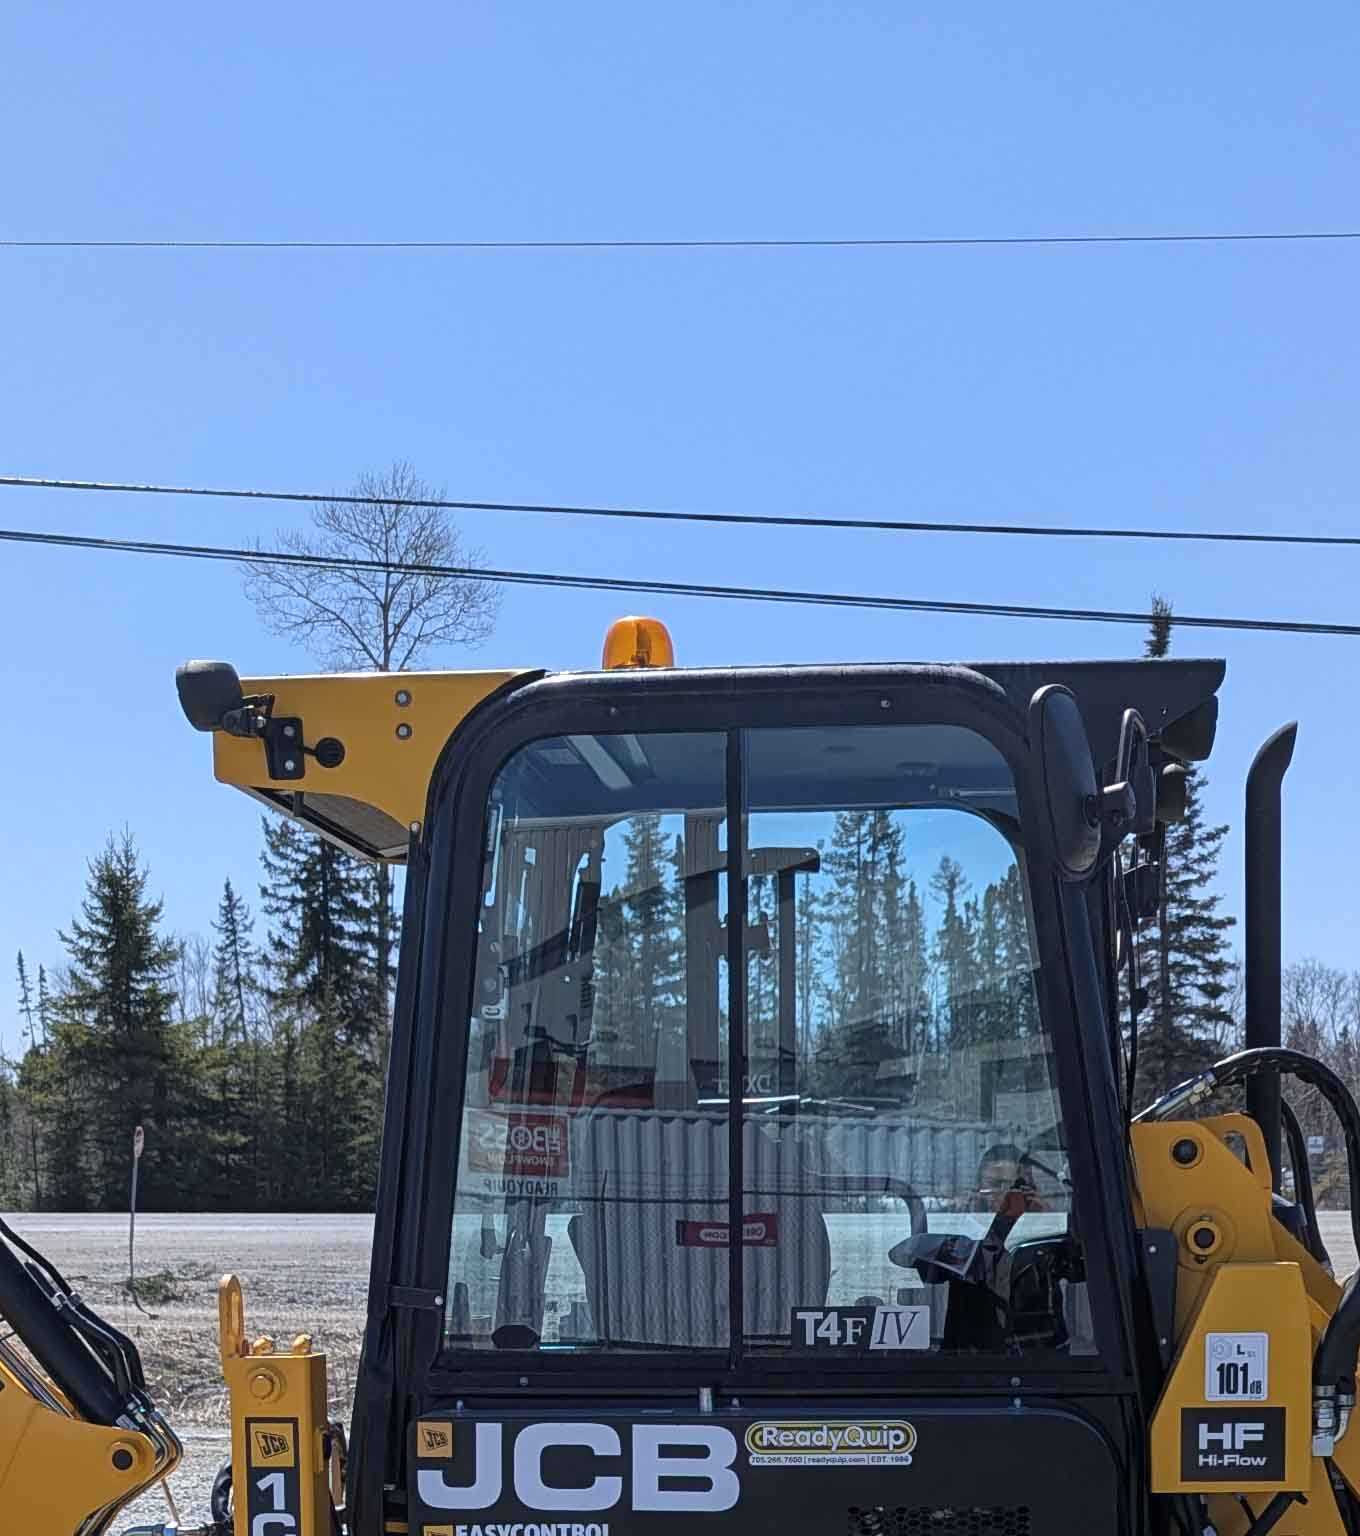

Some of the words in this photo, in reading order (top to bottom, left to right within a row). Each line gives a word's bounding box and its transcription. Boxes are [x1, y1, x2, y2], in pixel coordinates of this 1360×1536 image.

[1216, 1362, 1249, 1395] 101
[260, 1433, 289, 1457] JCB
[762, 1424, 905, 1452] ReadyQuip
[1198, 1422, 1265, 1450] HF
[417, 1422, 740, 1512] JCB
[1198, 1454, 1268, 1467] Hi-Flow
